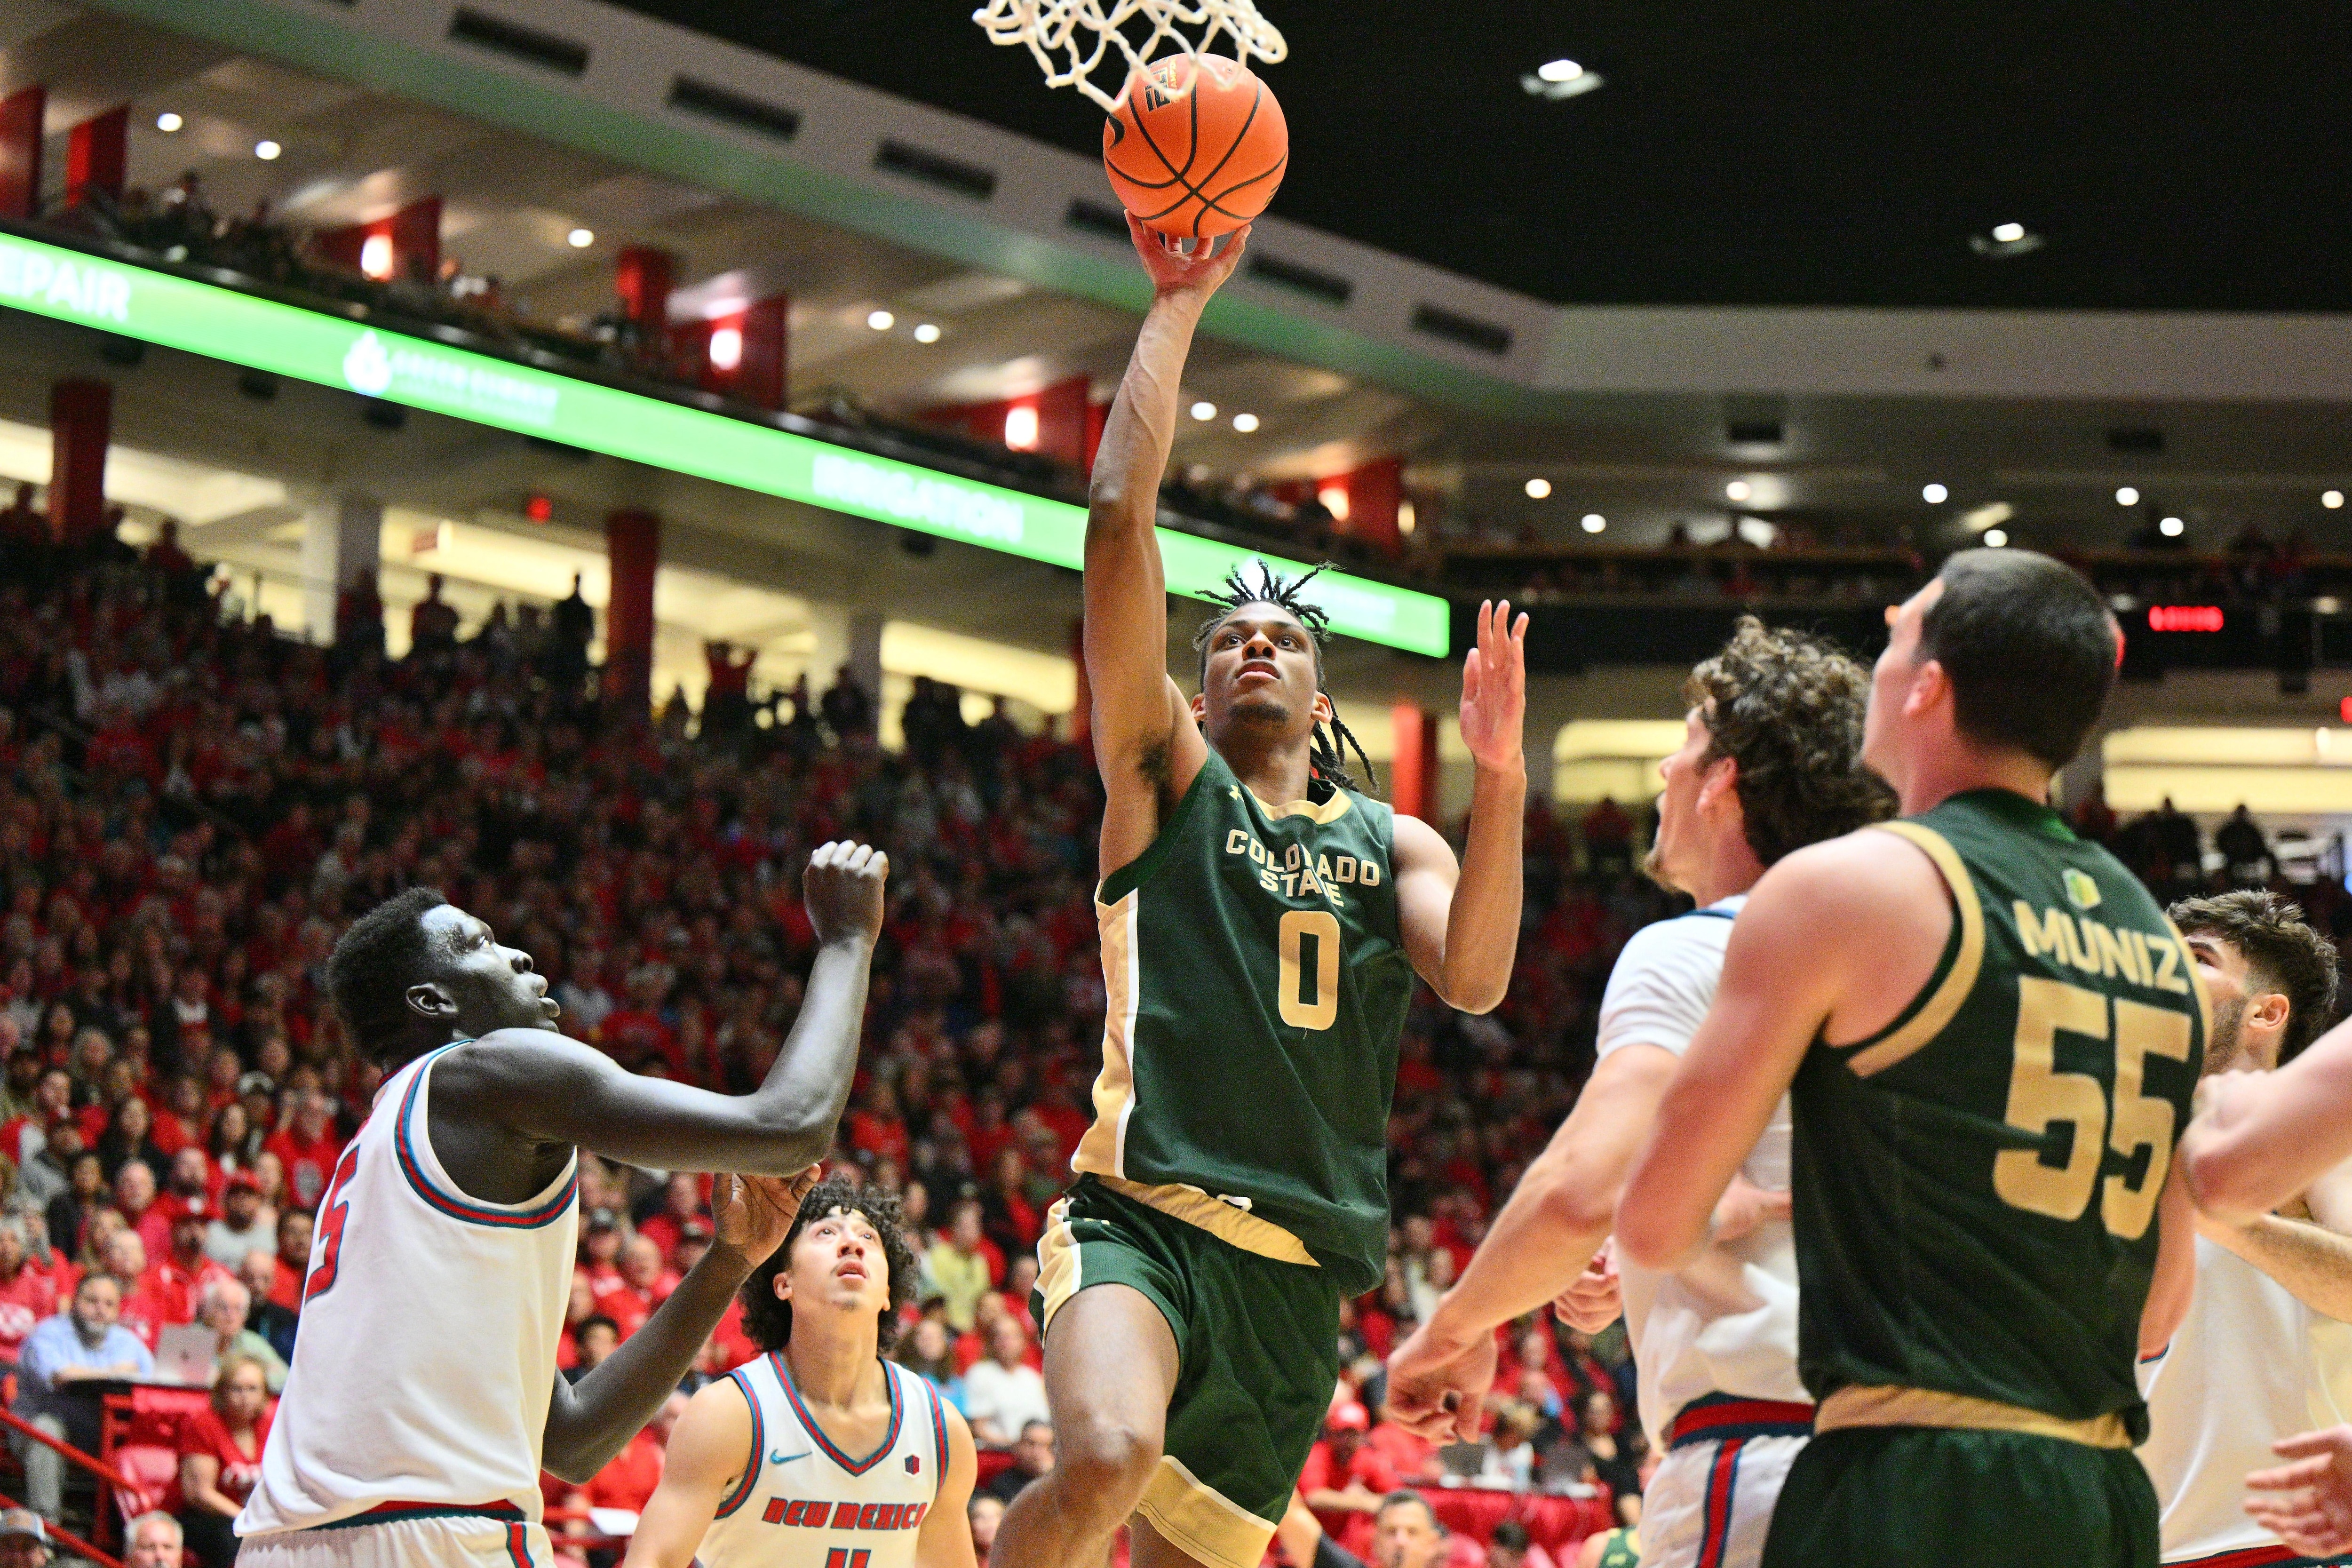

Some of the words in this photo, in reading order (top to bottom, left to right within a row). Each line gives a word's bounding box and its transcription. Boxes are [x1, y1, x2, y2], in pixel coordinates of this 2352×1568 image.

[1225, 829, 1380, 886] COLORADO
[1278, 910, 1341, 1031] 0
[2012, 899, 2190, 994] MUNIZ
[1993, 975, 2193, 1241] 55
[762, 1496, 833, 1528] NEW
